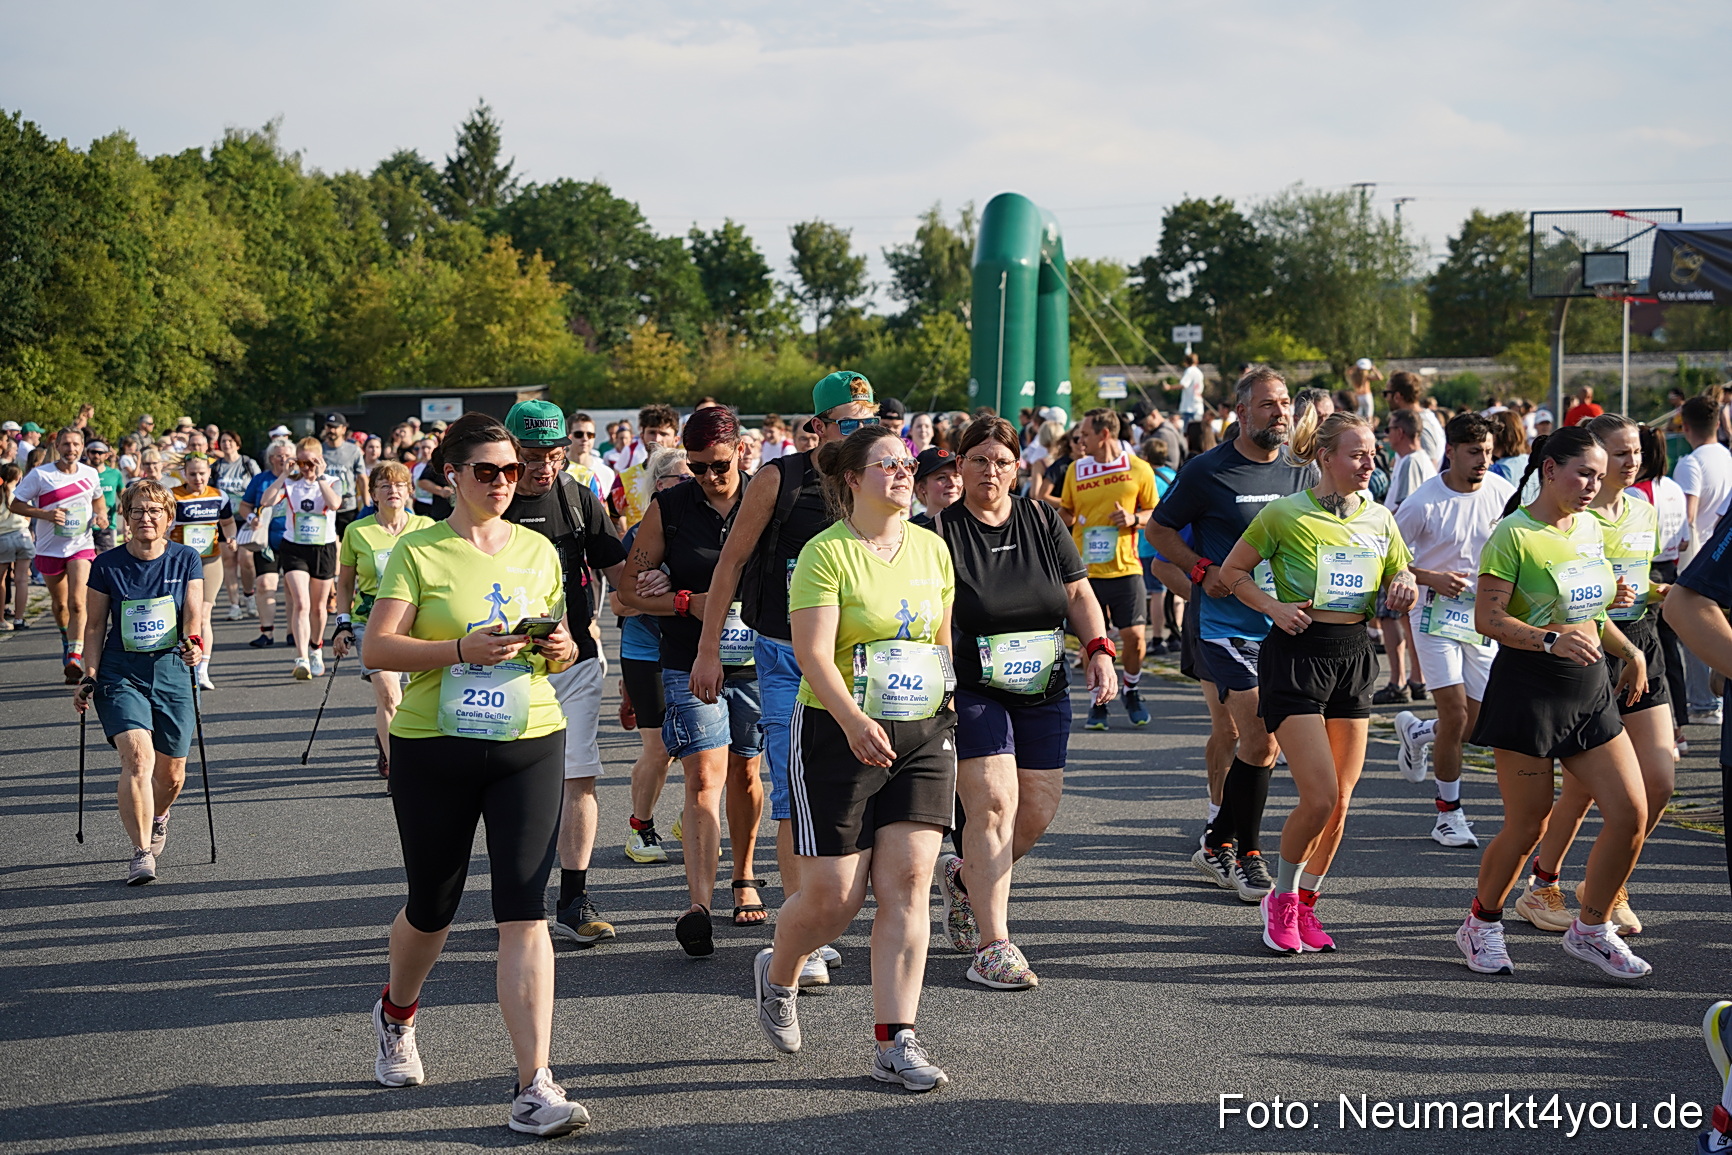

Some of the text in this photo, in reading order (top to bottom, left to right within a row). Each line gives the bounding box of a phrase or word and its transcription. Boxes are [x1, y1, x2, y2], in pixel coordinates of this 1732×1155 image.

[1076, 474, 1132, 492] MAX BÖGL
[300, 525, 320, 533] 2357
[1089, 541, 1109, 550] 1832
[1265, 571, 1275, 584] 2
[1330, 572, 1363, 588] 1338
[1570, 585, 1603, 602] 1383
[1445, 609, 1469, 623] 706
[133, 619, 165, 633] 1536
[720, 628, 754, 641] 2291
[1003, 660, 1042, 675] 2268
[888, 673, 923, 690] 242
[462, 688, 505, 708] 230
[882, 693, 929, 702] Carsten Zwick
[455, 709, 483, 718] Carolin
[484, 712, 512, 721] Geißler
